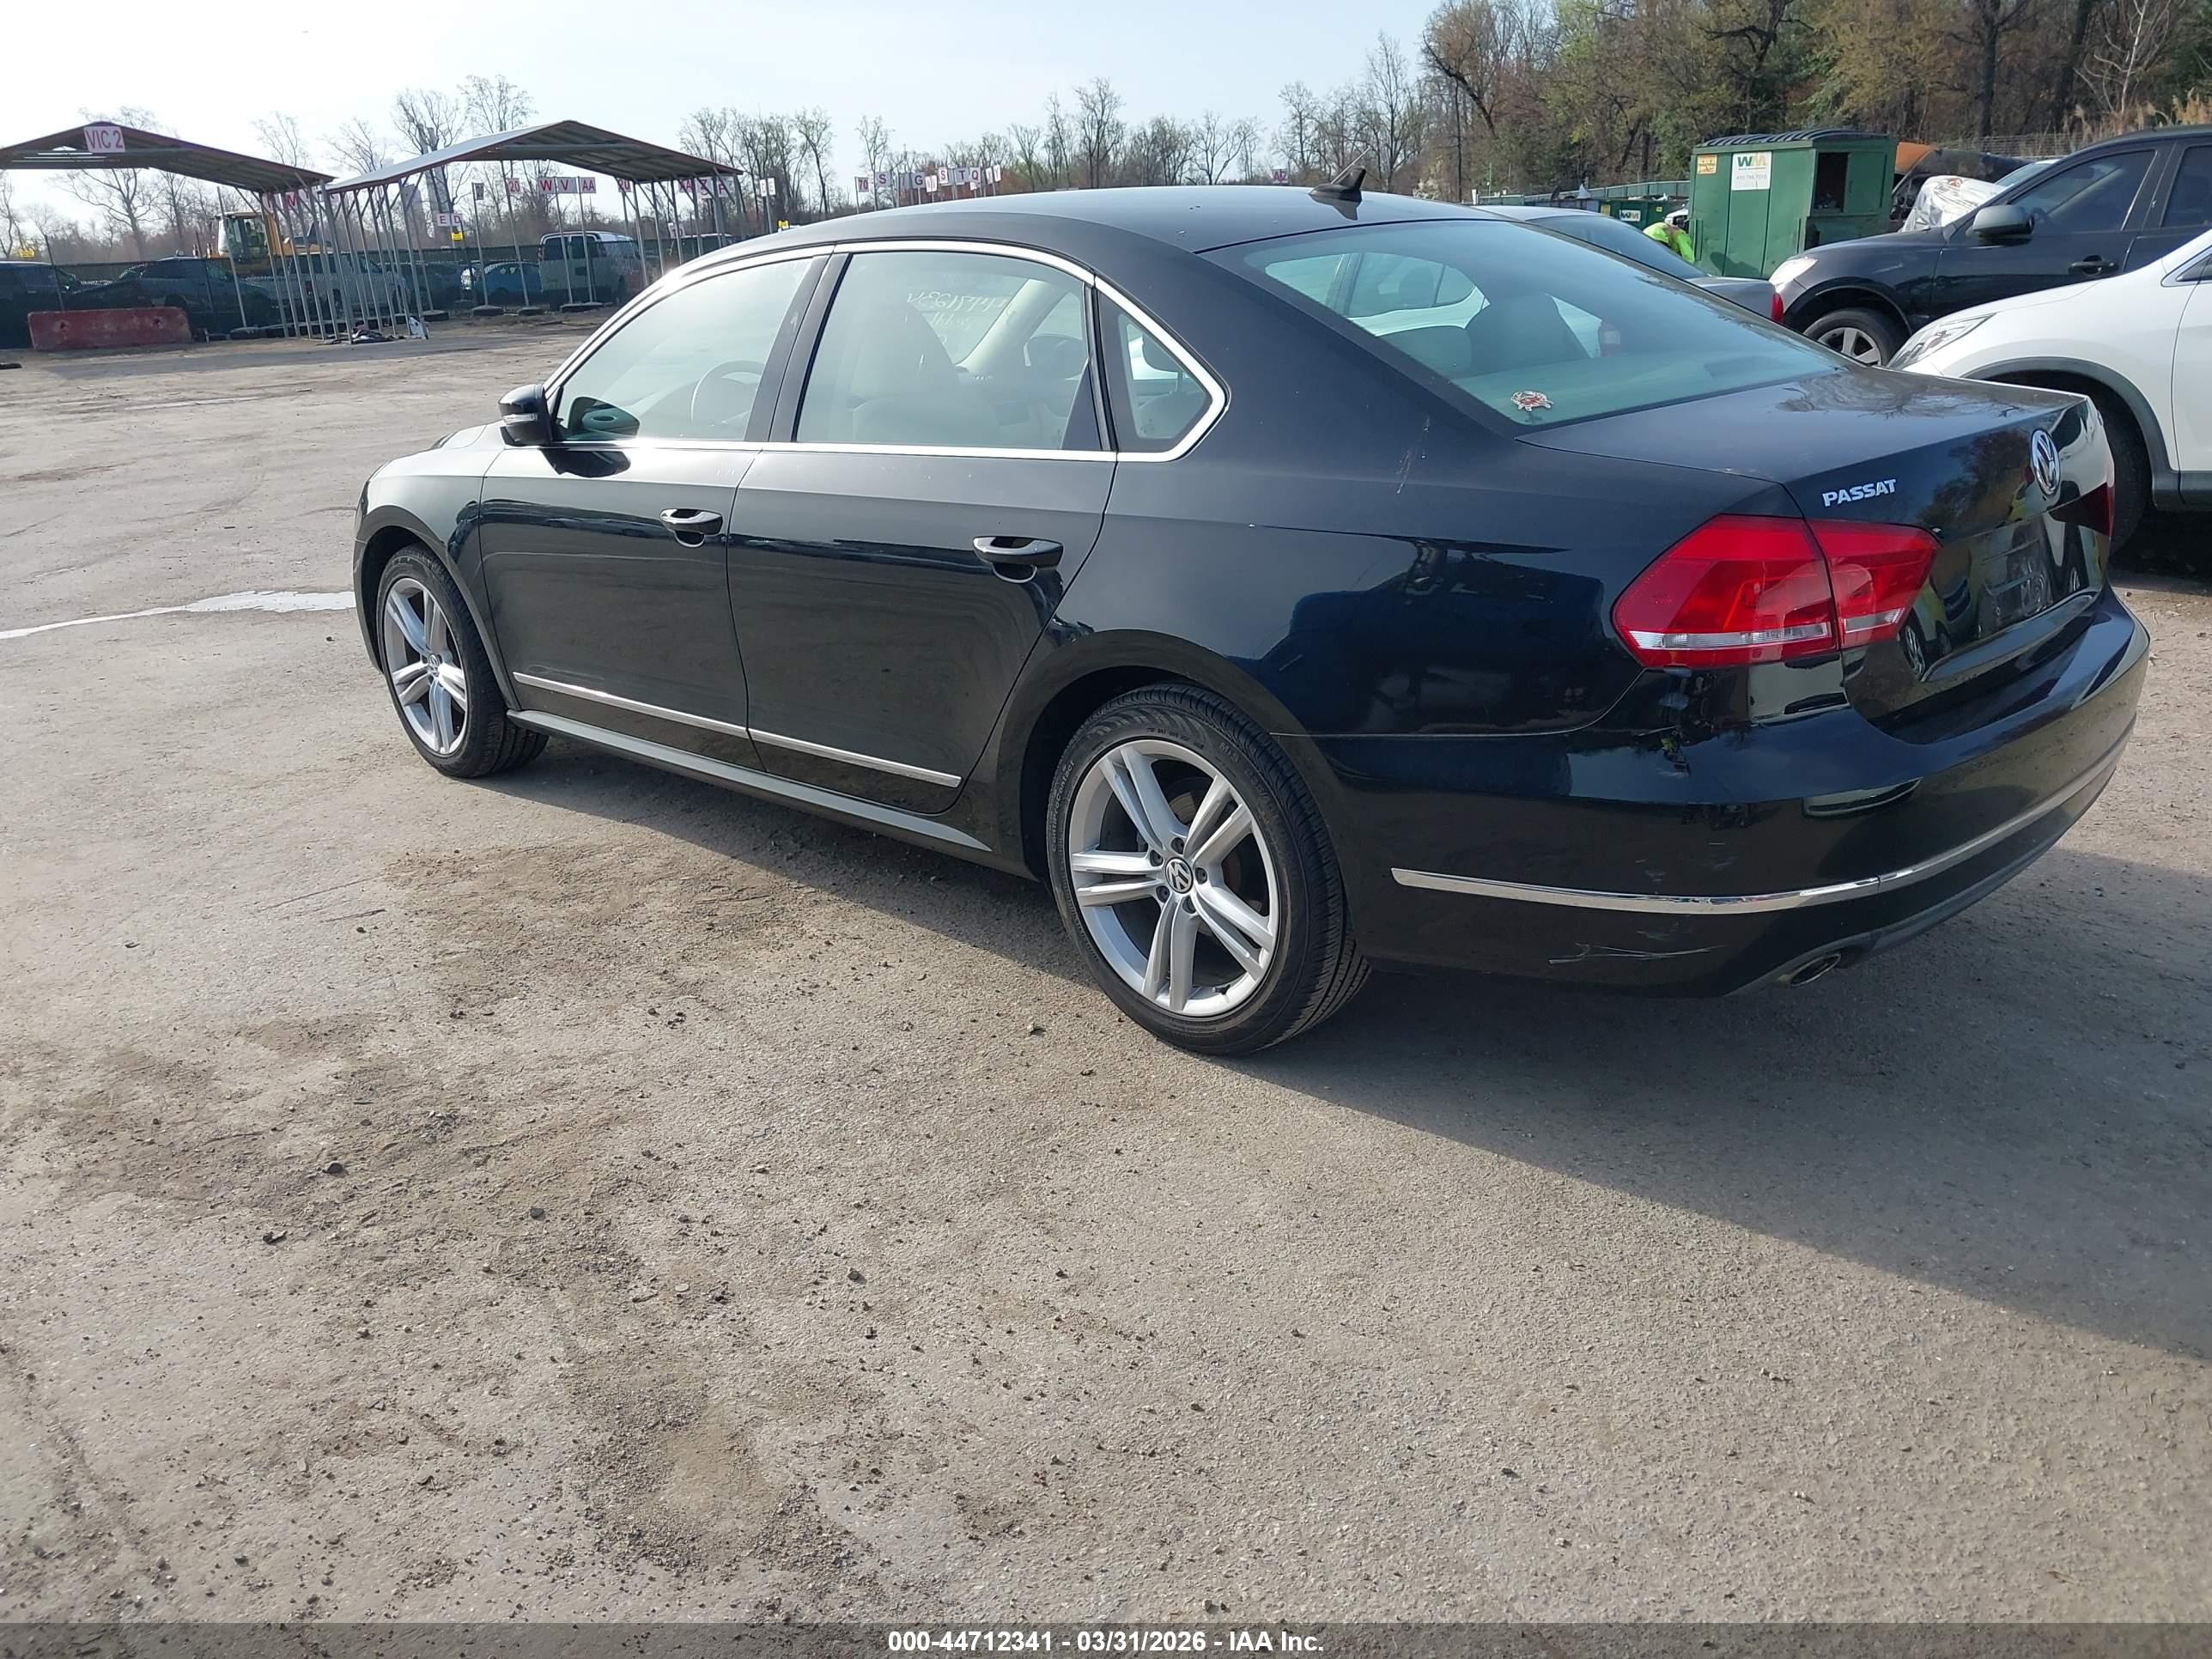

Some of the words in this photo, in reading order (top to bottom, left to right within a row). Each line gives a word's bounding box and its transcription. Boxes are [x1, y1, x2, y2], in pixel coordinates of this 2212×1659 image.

[86, 130, 111, 149] VIC
[113, 130, 123, 149] 2
[1737, 155, 1766, 167] WM
[878, 173, 887, 185] S
[914, 174, 924, 185] G
[958, 170, 966, 180] T
[508, 180, 520, 193] 20
[539, 179, 553, 191] W
[560, 179, 569, 191] V
[582, 179, 596, 191] AA
[858, 179, 868, 190] 70
[439, 215, 447, 224] E
[453, 215, 462, 224] D
[1821, 478, 1897, 507] PASSAT
